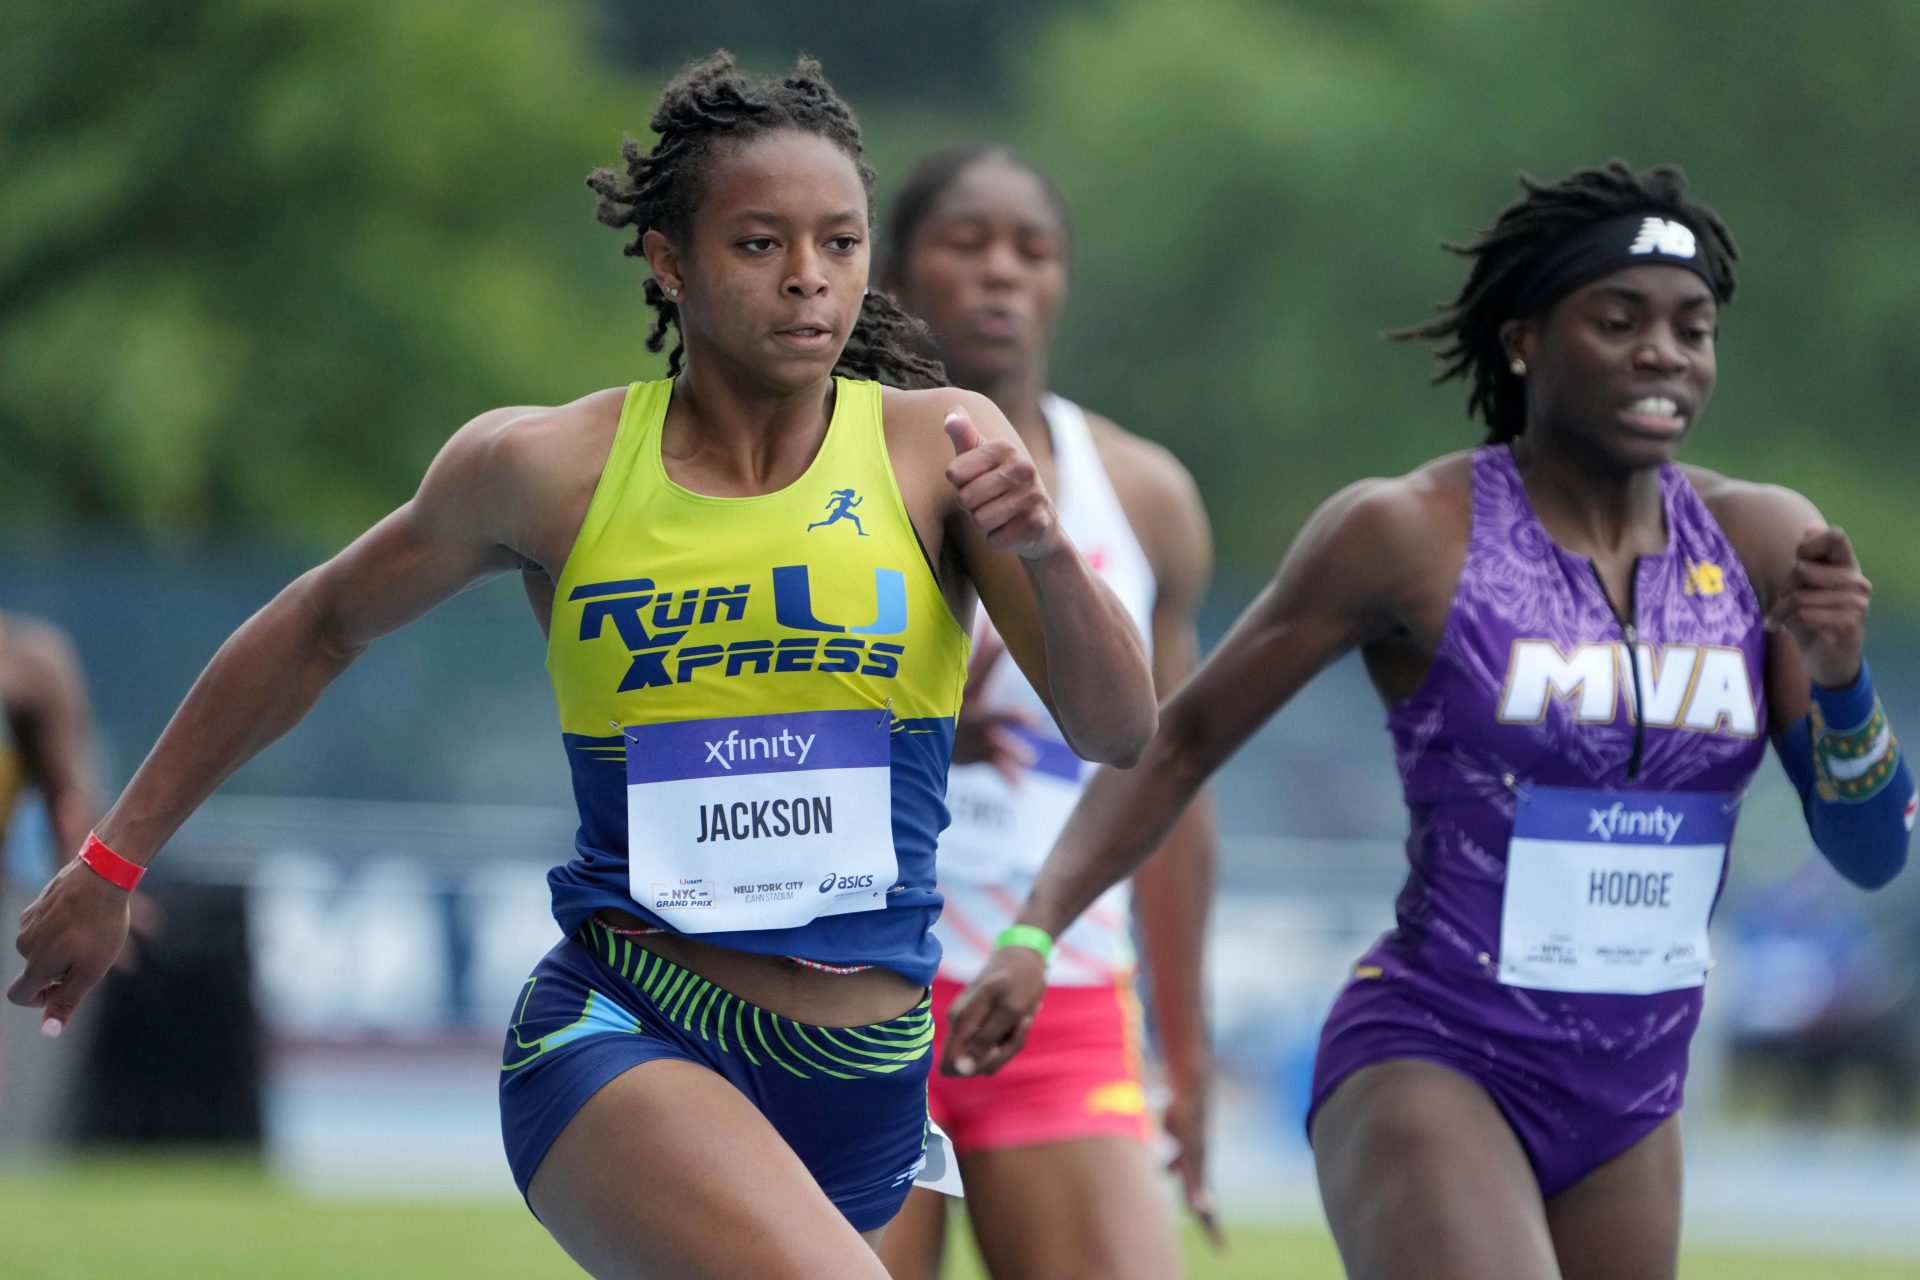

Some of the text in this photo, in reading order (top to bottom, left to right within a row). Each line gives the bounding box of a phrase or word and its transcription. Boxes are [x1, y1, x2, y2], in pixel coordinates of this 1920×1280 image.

[616, 630, 905, 693] XPRESS
[1496, 638, 1759, 739] MVA
[704, 728, 816, 769] xfinity
[696, 796, 833, 843] JACKSON
[1587, 801, 1684, 844] xfinity
[656, 900, 689, 908] GRAND
[671, 888, 696, 900] NYC
[733, 881, 804, 894] NEW YORK CITY
[1588, 871, 1674, 908] HODGE
